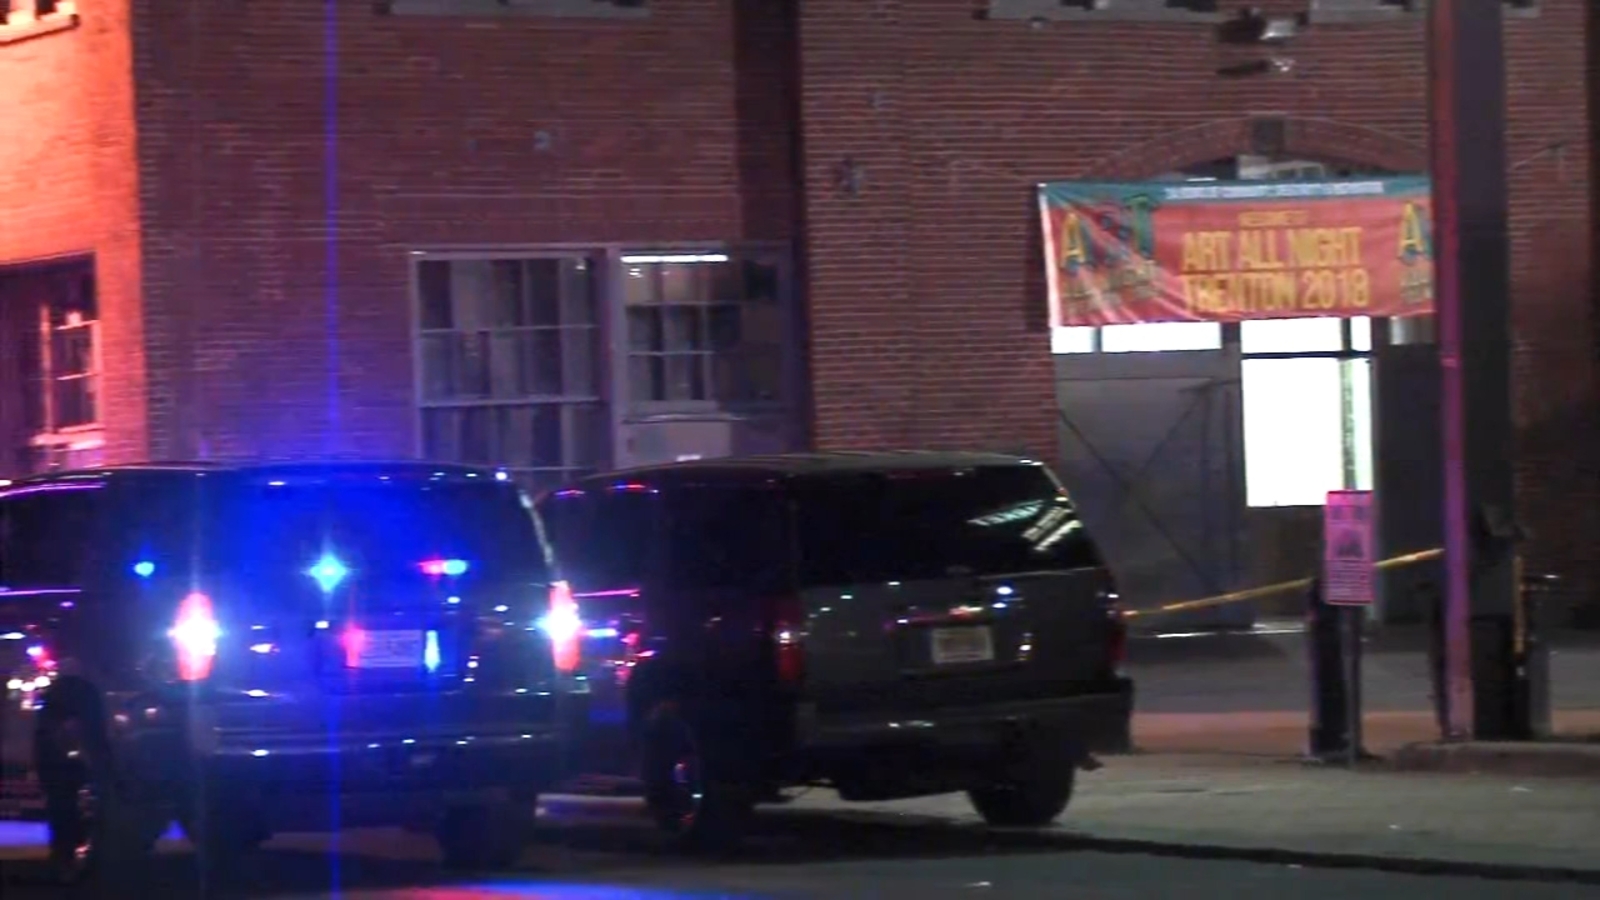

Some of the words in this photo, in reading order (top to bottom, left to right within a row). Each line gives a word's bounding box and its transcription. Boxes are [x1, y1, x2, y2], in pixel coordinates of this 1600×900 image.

[1182, 231, 1232, 271] ART
[1238, 229, 1284, 268] ALL
[1287, 227, 1362, 266] NIGHT
[1302, 269, 1369, 308] 2018
